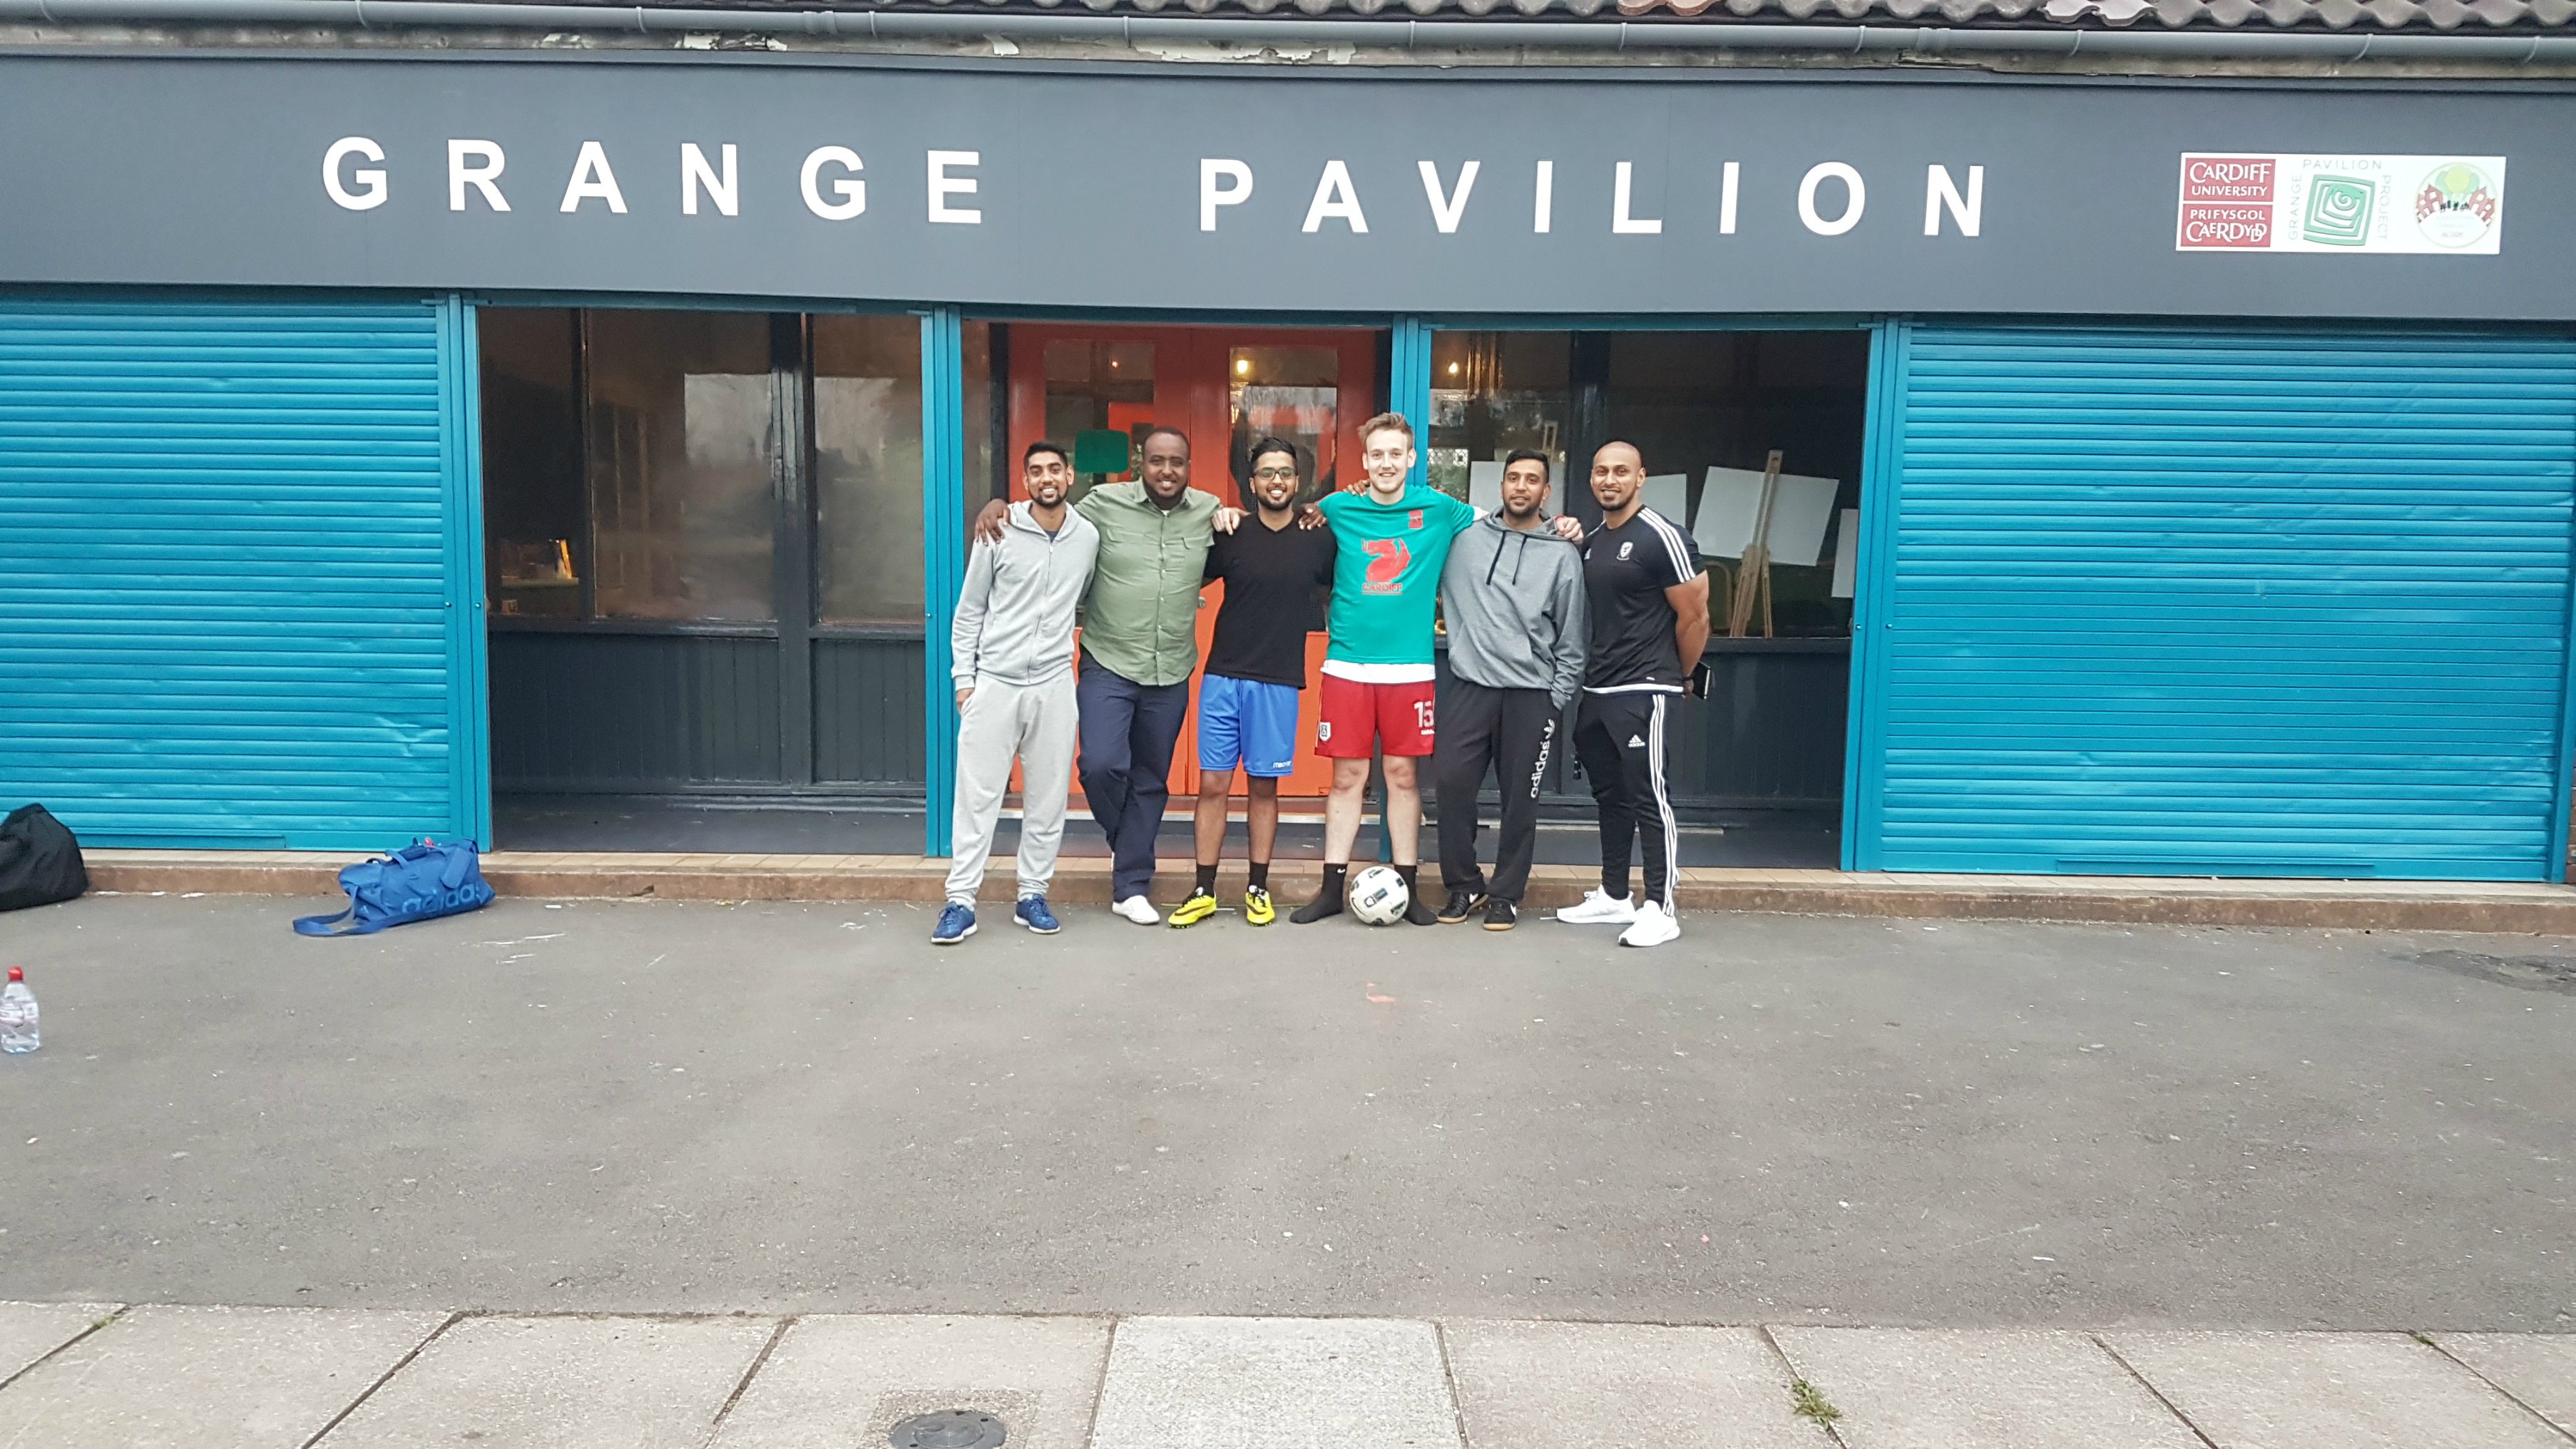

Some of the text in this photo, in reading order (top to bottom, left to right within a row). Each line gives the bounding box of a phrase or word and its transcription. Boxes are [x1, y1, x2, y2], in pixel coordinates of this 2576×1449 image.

[2189, 162, 2272, 184] CARDIFF
[2303, 158, 2382, 170] PAVILION
[322, 135, 1984, 237] GRANGE PAVILION
[2192, 185, 2268, 197] UNIVERSITY
[2189, 208, 2266, 220] PRIFYSGOL
[2288, 173, 2302, 241] GRANGE
[2377, 174, 2391, 240] PROJECT
[1361, 583, 1403, 592] CARDIFF
[1414, 700, 1434, 727] 15
[1530, 739, 1551, 798] adidas
